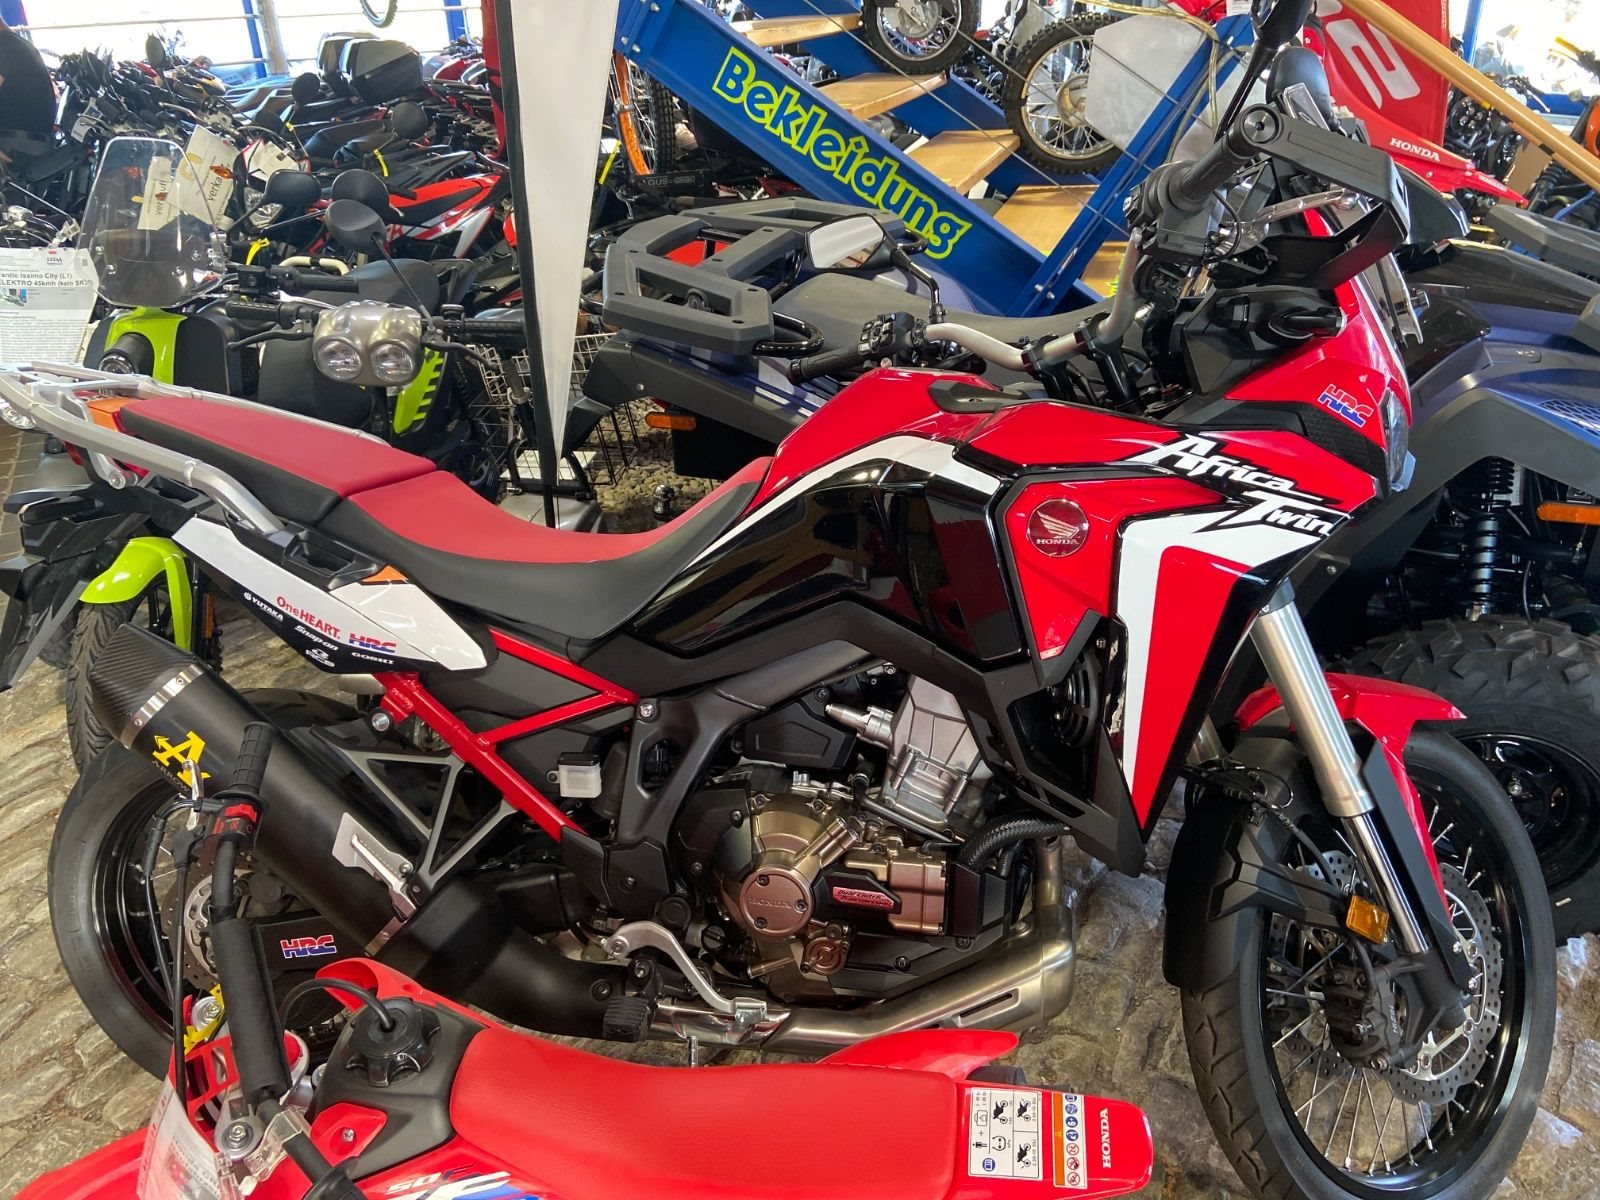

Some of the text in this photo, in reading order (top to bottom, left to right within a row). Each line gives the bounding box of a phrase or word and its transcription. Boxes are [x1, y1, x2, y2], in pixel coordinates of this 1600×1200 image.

[712, 46, 973, 260] Bekleidung
[1389, 138, 1440, 161] HONDA
[1318, 384, 1374, 428] HRC
[1124, 433, 1324, 502] Africa
[1218, 489, 1351, 537] Twin
[252, 597, 284, 622] YUTAKA
[294, 625, 339, 651] Snap-on
[348, 633, 397, 653] HRC
[351, 651, 395, 665] GOSHI
[280, 934, 337, 959] HRC
[1100, 1108, 1111, 1169] HONDA
